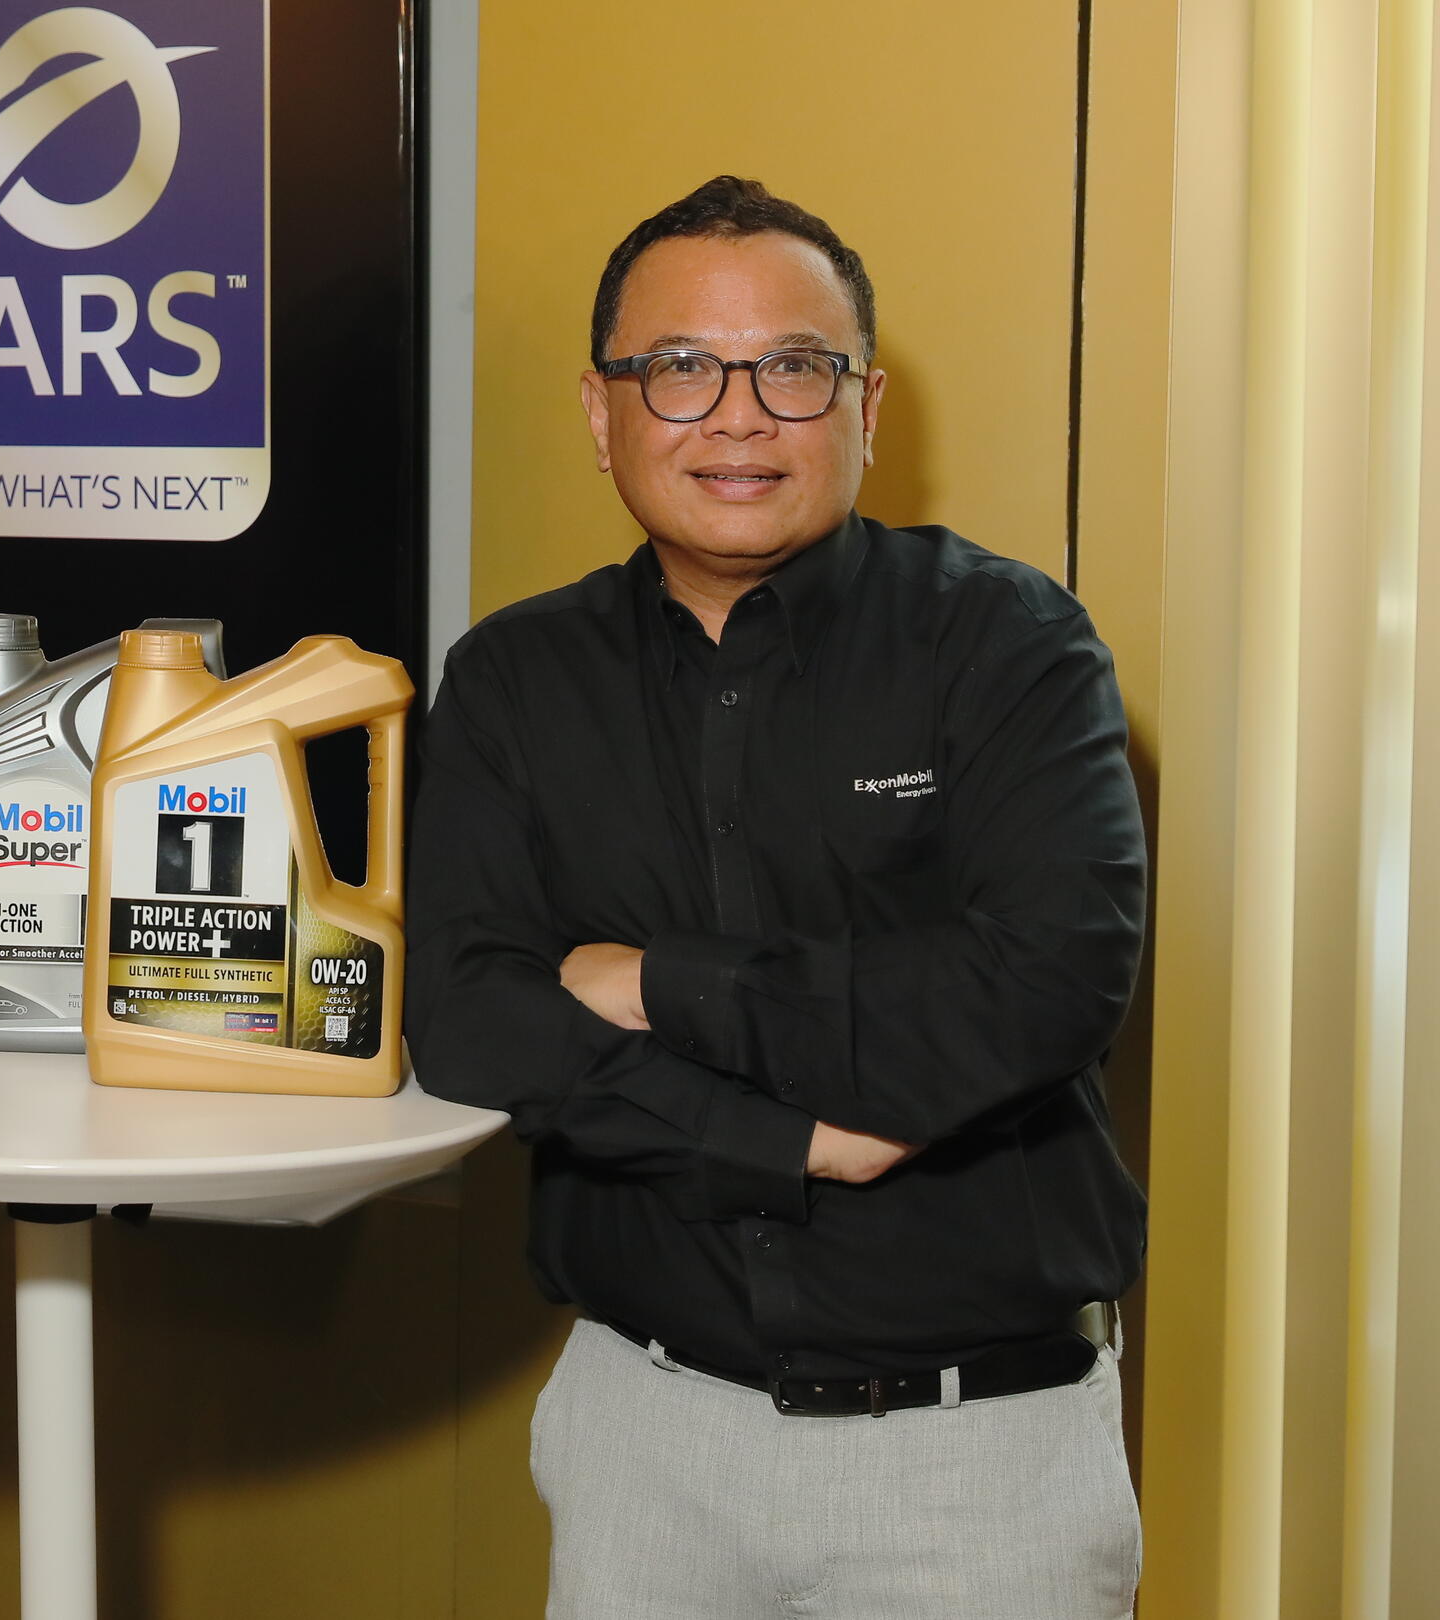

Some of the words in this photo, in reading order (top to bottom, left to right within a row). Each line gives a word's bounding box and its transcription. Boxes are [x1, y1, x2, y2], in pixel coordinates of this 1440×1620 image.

[854, 769, 933, 794] ExxonMobil
[158, 784, 246, 814] Mobil
[182, 821, 213, 892] 1
[130, 905, 195, 928] TRIPLE
[200, 908, 271, 930] ACTION
[12, 948, 57, 958] Smoother
[129, 965, 181, 978] ULTIMATE
[184, 967, 211, 980] FULL
[214, 969, 273, 983] SYNTHETIC
[311, 958, 367, 985] 0W-20
[129, 989, 165, 1000] PETROL
[177, 991, 211, 1002] DIESEL
[222, 993, 260, 1004] HYBRID
[328, 987, 339, 995] API
[340, 987, 349, 995] SP
[128, 1004, 140, 1014] 4L
